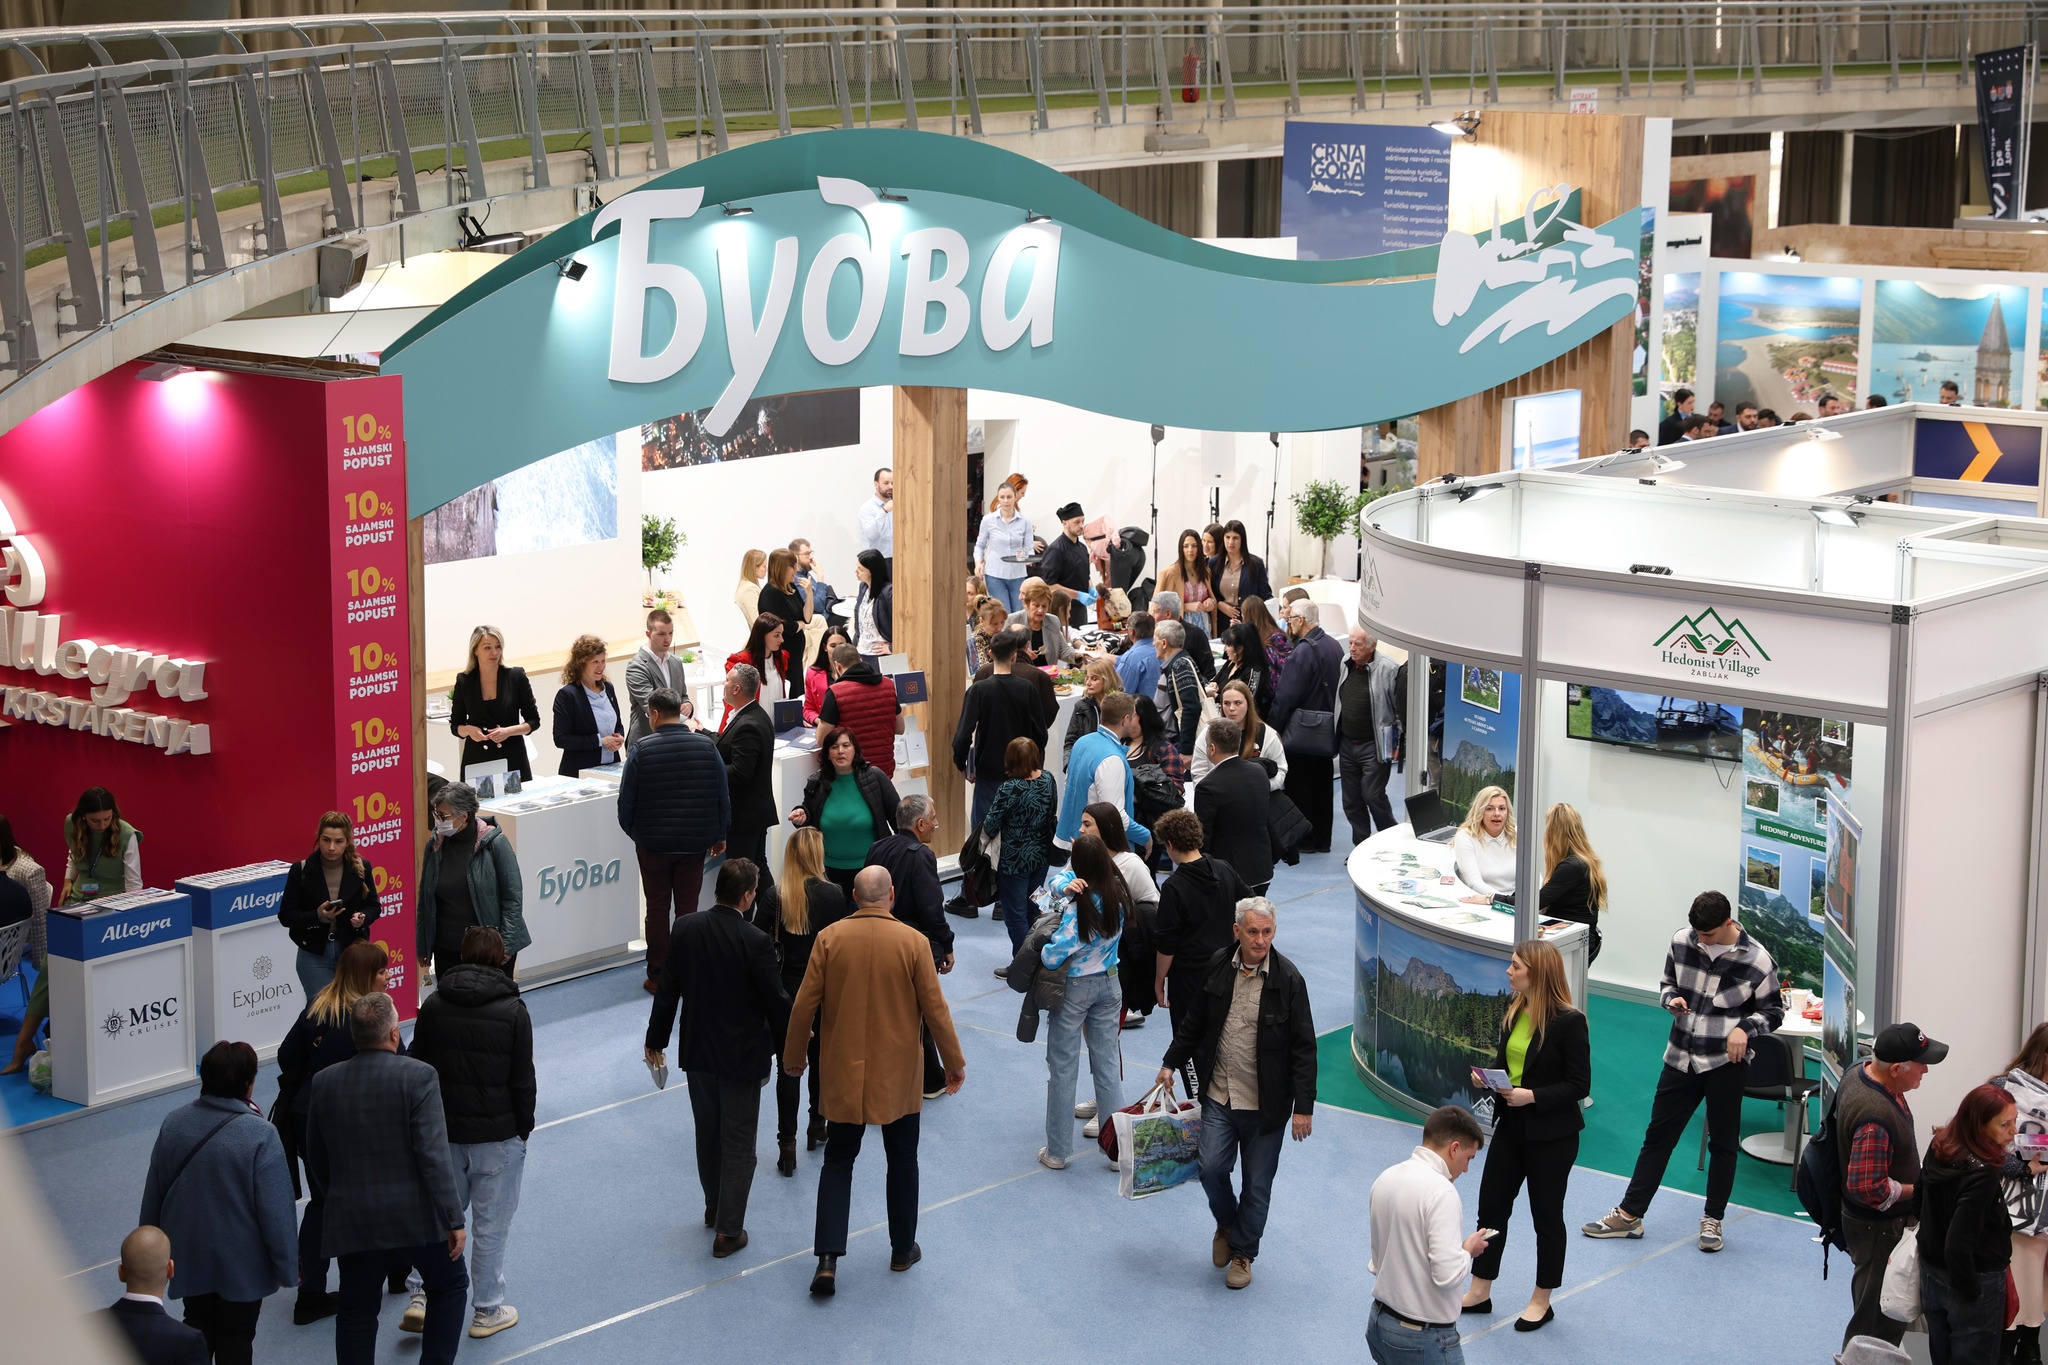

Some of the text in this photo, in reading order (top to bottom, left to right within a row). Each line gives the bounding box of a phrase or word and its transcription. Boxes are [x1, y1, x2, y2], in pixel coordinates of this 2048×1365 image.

[1312, 143, 1366, 163] CRNA
[1311, 161, 1366, 181] GORA
[1384, 167, 1416, 176] Nacionalna
[1384, 175, 1417, 183] organizacija
[1384, 188, 1428, 198] AIR Montenegro
[591, 175, 1062, 437] Будва
[342, 413, 391, 444] 10%
[343, 442, 392, 457] SAJAMSKI
[343, 454, 392, 470] POPUST
[345, 490, 394, 520] 10%
[345, 519, 394, 534] SAJAMSKI
[345, 530, 394, 547] POPUST
[347, 566, 395, 596] 10%
[347, 595, 396, 610] SAJAMSKI
[347, 606, 396, 623] POPUST
[349, 642, 398, 673] 10%
[1662, 651, 1760, 677] Hedonist Village
[349, 670, 398, 686] SAJAMSKI
[1691, 669, 1729, 680] ŽABLJAK
[349, 681, 398, 699] POPUST
[3, 686, 211, 755] KRSTARENJA
[351, 717, 399, 748] 10%
[352, 744, 400, 761] SAJAMSKI
[352, 755, 400, 774] POPUST
[353, 792, 401, 822] 10%
[353, 818, 402, 836] SAJAMSKI
[1760, 824, 1827, 848] HEDONIST ADVENTURES
[354, 829, 402, 848] POPUST
[372, 866, 402, 893] 0%
[536, 858, 621, 905] Будва
[229, 890, 284, 913] Allegr
[101, 917, 172, 943] Allegra
[233, 982, 293, 1012] Explora
[129, 997, 178, 1027] MSC
[246, 1004, 282, 1019] JOURNEYS
[129, 1018, 179, 1037] CRUISES
